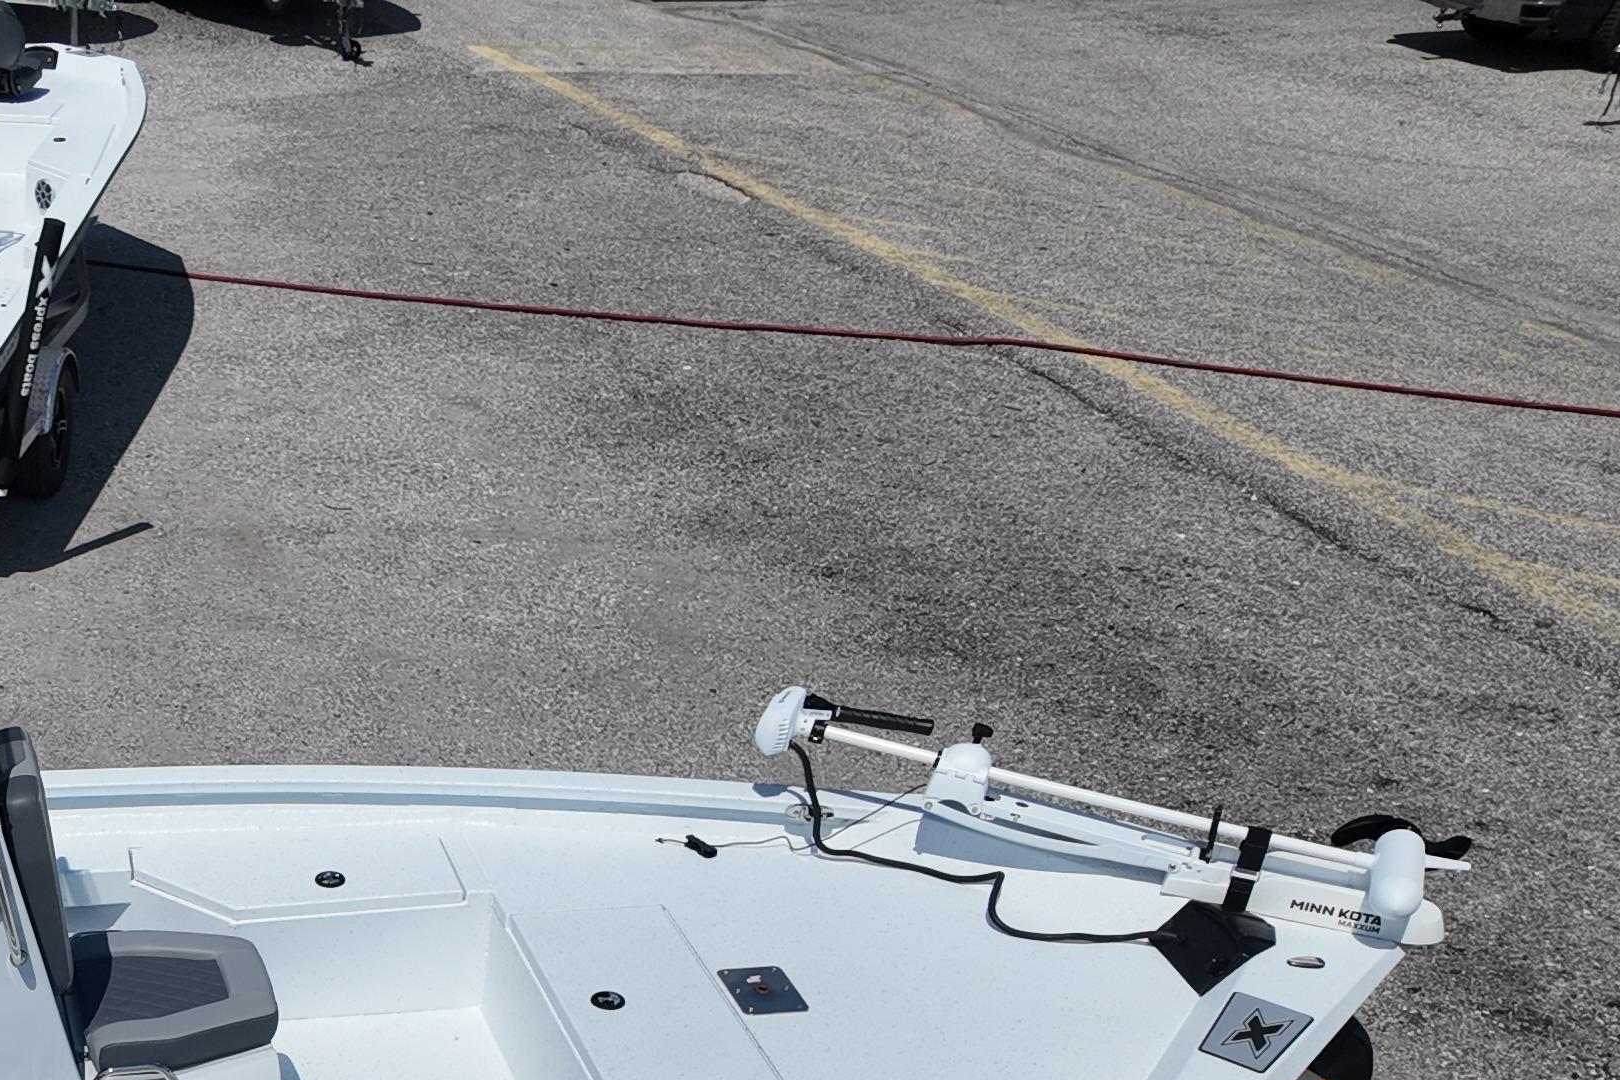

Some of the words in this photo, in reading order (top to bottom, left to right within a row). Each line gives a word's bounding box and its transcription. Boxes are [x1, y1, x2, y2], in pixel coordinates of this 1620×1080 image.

[20, 354, 38, 397] boats
[1290, 899, 1335, 917] MINN
[1338, 908, 1382, 926] KOTA
[1337, 919, 1381, 934] MAXXUM
